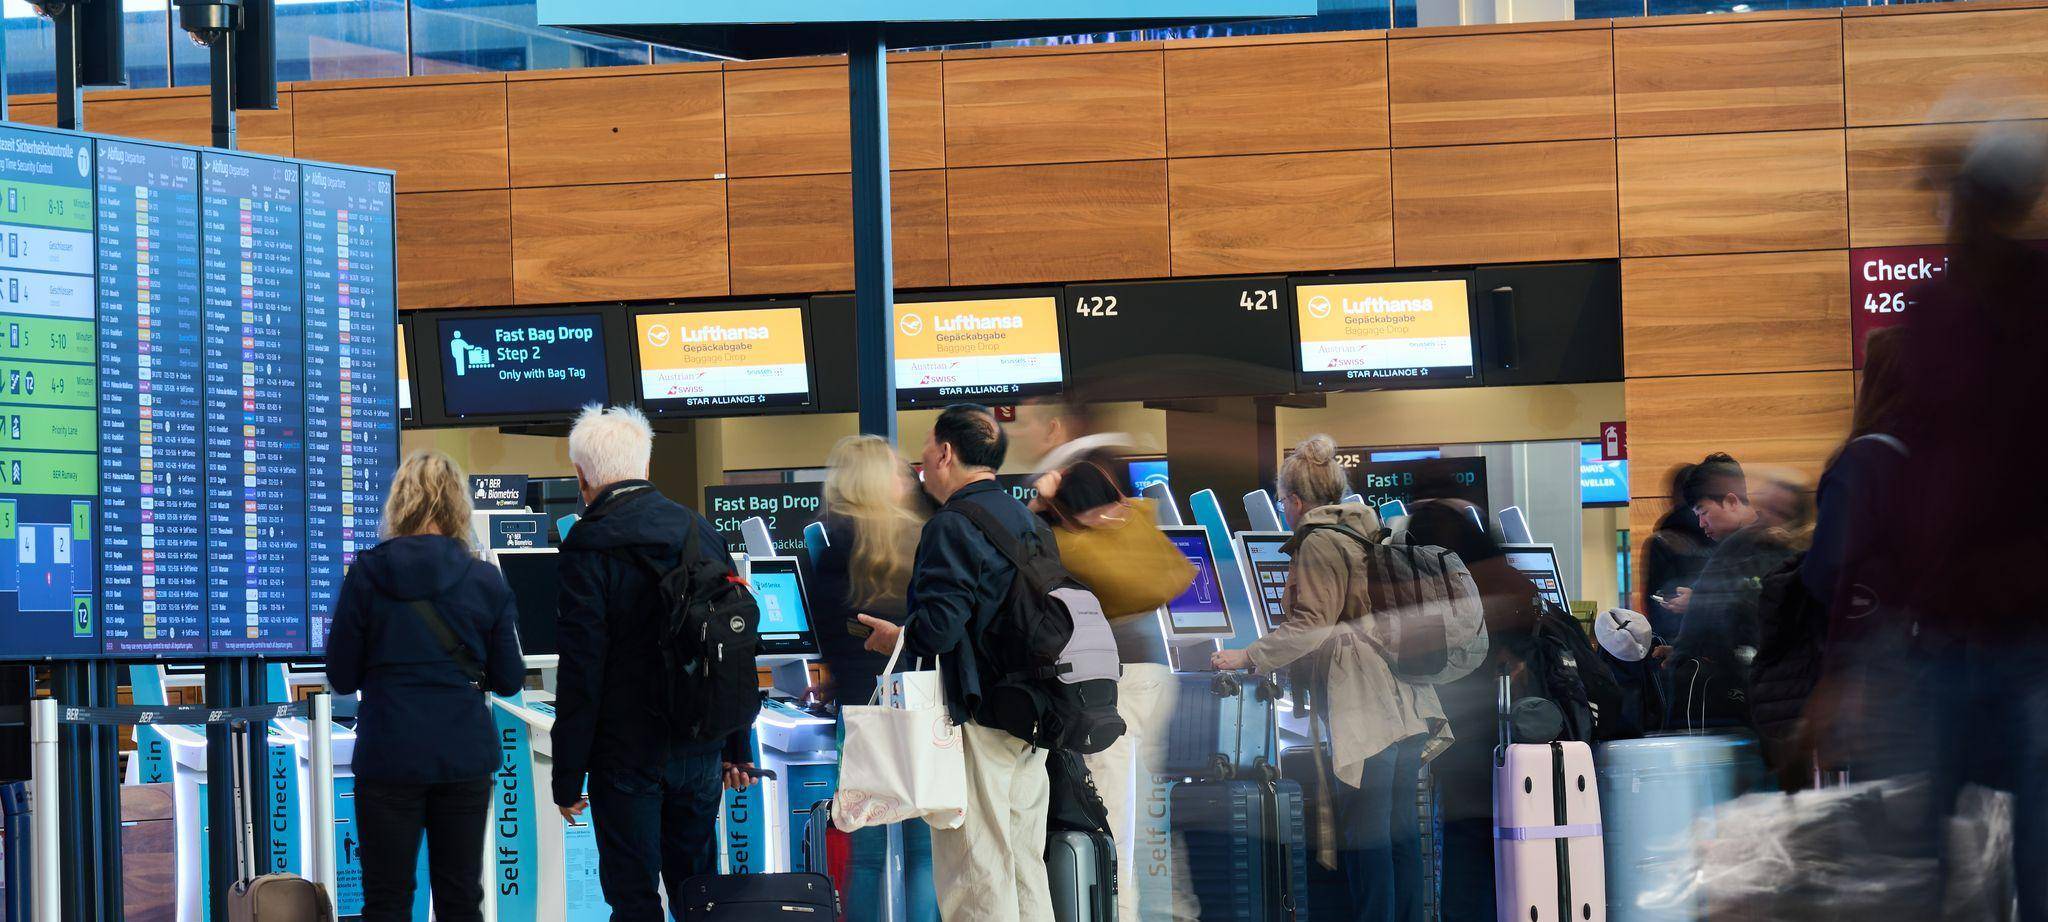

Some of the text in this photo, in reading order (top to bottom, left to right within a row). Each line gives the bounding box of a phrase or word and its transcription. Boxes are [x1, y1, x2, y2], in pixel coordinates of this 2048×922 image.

[16, 139, 74, 158] Sicherheitskontrolle
[107, 147, 146, 165] Abflug Departure
[5, 158, 17, 170] Time
[17, 160, 36, 175] Security
[36, 162, 53, 174] Control
[212, 160, 250, 177] Abflug Departure
[312, 173, 346, 189] Abflug Departure
[22, 196, 90, 216] 1 8-13 Minuten
[23, 241, 73, 256] 2 Geschlossen
[1863, 256, 1949, 282] Check-i
[24, 285, 74, 301] 4 Geschlossen
[1239, 289, 1278, 311] 421
[1076, 296, 1118, 317] 422
[1342, 296, 1433, 314] Lufthansa
[1864, 292, 1906, 314] 426
[934, 314, 1023, 332] Lufthansa
[1344, 314, 1416, 325] Gepäckabgabe
[495, 326, 593, 344] Fast Bag Drop
[680, 325, 769, 343] Lufthansa
[936, 332, 1006, 342] Gepäckabgabe
[1345, 324, 1409, 336] Baggage Drop
[24, 331, 29, 346] 5
[50, 333, 66, 350] 5-10
[76, 332, 93, 342] Minuten
[683, 342, 753, 353] Gepäckabgabe
[937, 342, 1000, 354] Baggage Drop
[497, 346, 541, 363] Step 2
[1319, 344, 1355, 354] Austrian
[684, 352, 746, 364] Baggage Drop
[1339, 358, 1365, 366] SWISS
[911, 362, 947, 371] Austrian
[1347, 368, 1418, 378] STAR ALLIANCE
[499, 368, 586, 382] Only with Bag Tag
[658, 372, 695, 382] Austrian
[931, 375, 957, 383] SWISS
[25, 376, 34, 389] T2
[51, 378, 64, 394] 4-9
[76, 376, 94, 387] Minuten
[678, 386, 704, 394] SWISS
[939, 384, 1009, 395] STAR ALLIANCE
[686, 395, 756, 406] STAR ALLIANCE
[52, 425, 78, 437] Priority Lane
[52, 470, 78, 482] BER Runway
[489, 479, 501, 488] BER
[1367, 473, 1398, 488] Fast
[488, 488, 519, 499] Biometrics
[1012, 486, 1038, 500] Dro
[714, 495, 820, 513] Fast Bag Drop
[5, 513, 9, 528] 5
[80, 514, 84, 529] 1
[768, 517, 777, 529] 2
[25, 537, 30, 552] 4
[60, 537, 64, 553] 2
[78, 608, 88, 623] T2
[66, 708, 79, 721] BER
[139, 711, 154, 724] BER
[208, 710, 223, 722] BER
[276, 704, 288, 717] BER
[498, 728, 519, 896] Self Check-in
[273, 838, 287, 875] elf
[731, 831, 748, 874] Self
[1146, 827, 1167, 877] Self
